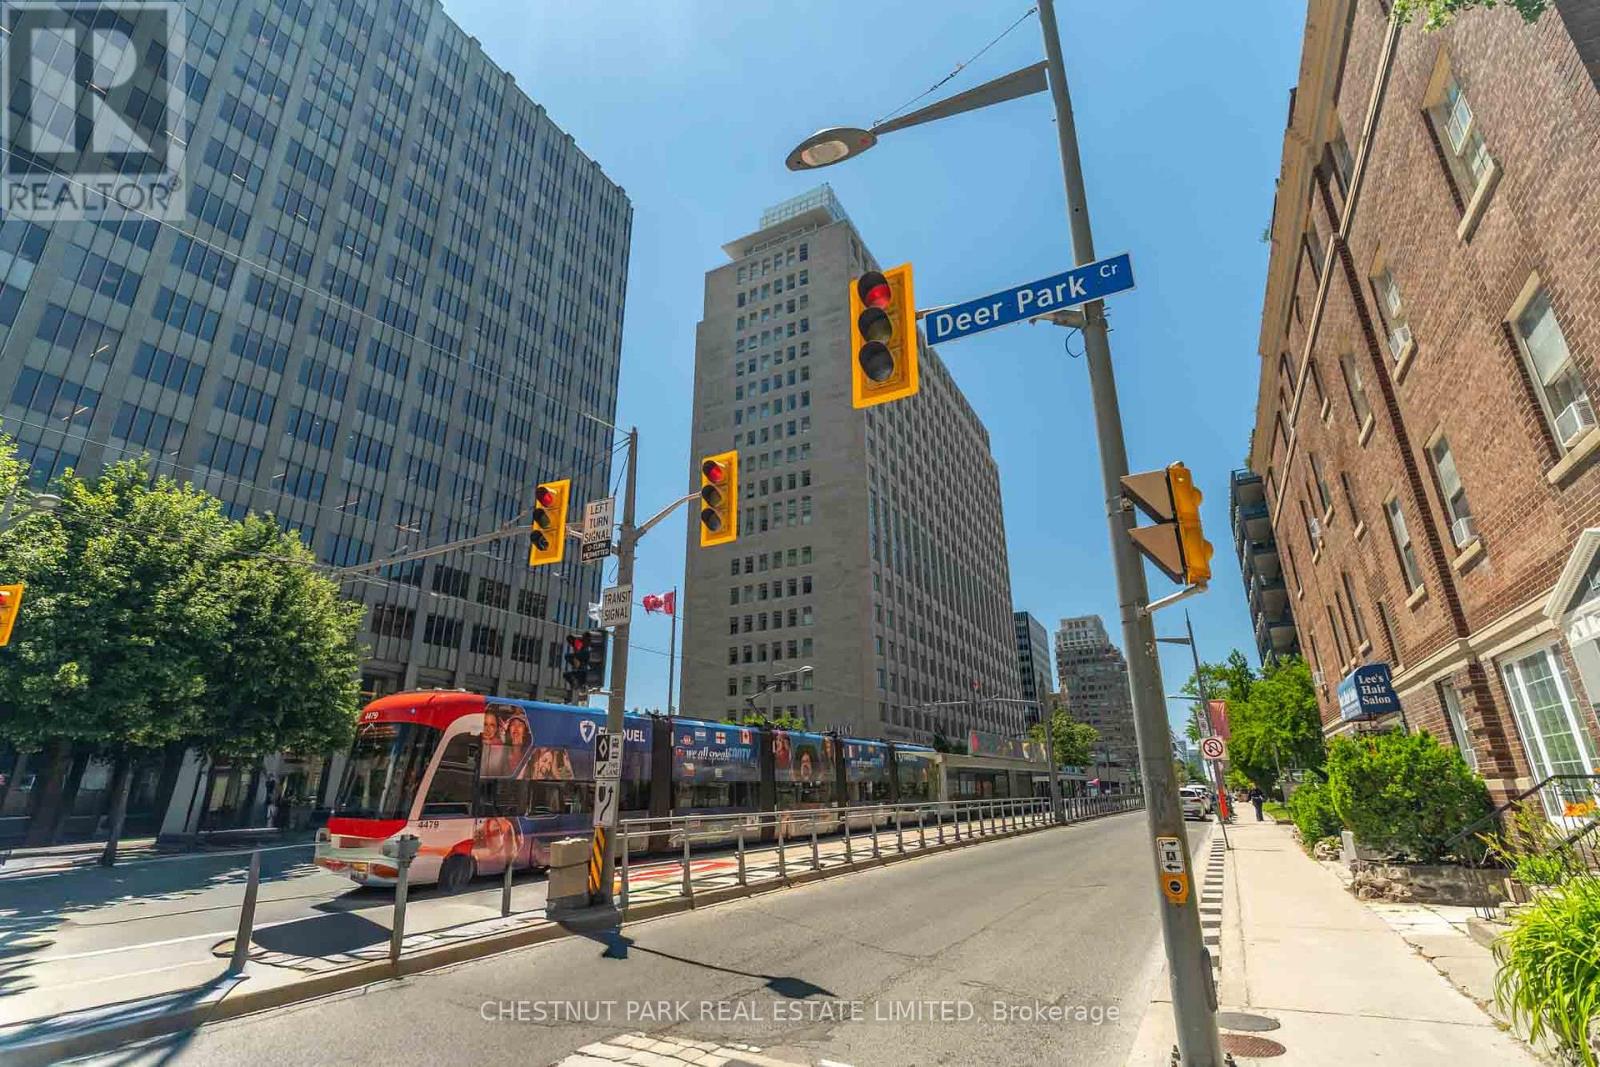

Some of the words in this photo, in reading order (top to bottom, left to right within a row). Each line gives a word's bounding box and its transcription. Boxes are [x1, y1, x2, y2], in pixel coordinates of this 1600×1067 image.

[936, 301, 1003, 337] Deer
[1017, 276, 1087, 313] Park
[1099, 264, 1118, 278] Cr
[590, 502, 608, 515] LEFT
[589, 515, 608, 529] TURN
[584, 529, 610, 543] SIGNAL
[604, 590, 631, 606] TRANSIT
[604, 606, 628, 621] SIGNAL
[1358, 674, 1384, 684] Lee's
[1360, 685, 1386, 695] Hair
[1362, 695, 1391, 705] Salon
[698, 746, 709, 760] all
[709, 747, 729, 763] speak
[417, 821, 439, 829] 4479
